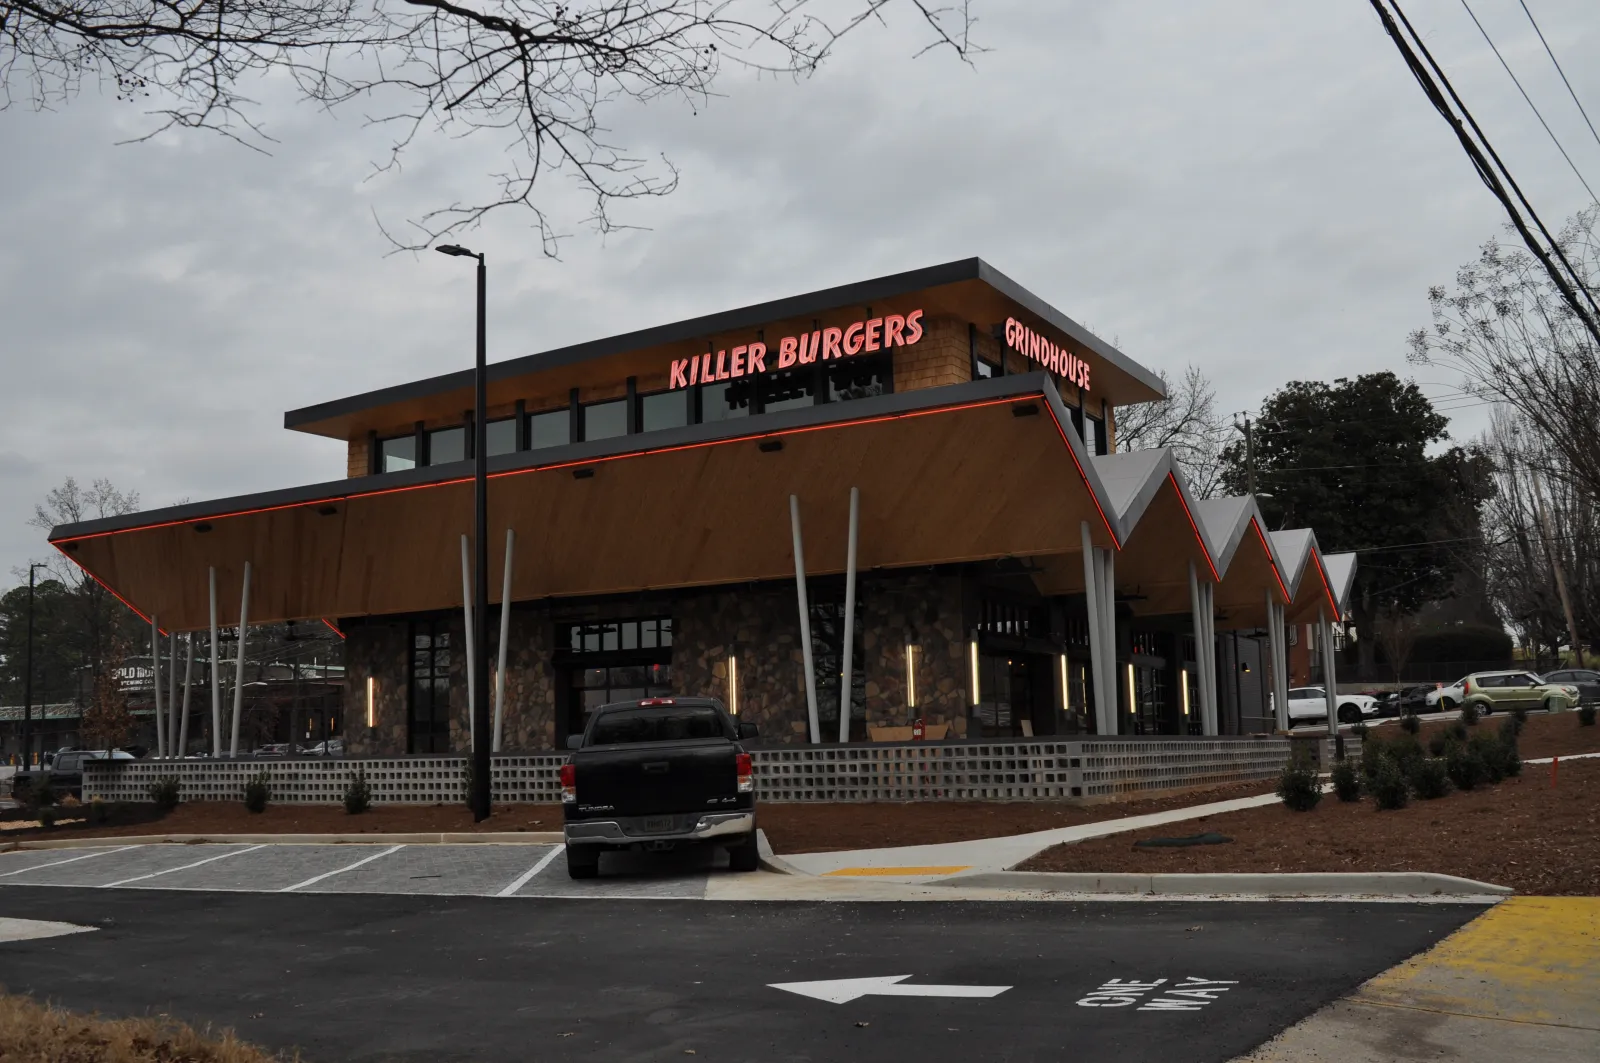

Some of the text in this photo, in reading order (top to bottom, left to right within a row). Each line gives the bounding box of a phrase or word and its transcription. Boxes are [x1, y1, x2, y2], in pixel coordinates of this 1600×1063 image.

[668, 309, 924, 391] KILLER BURGERS
[1004, 316, 1091, 392] GRINDHOUSE
[578, 805, 615, 813] TUNDRA
[1075, 978, 1168, 1008] ONE
[1136, 976, 1240, 1011] WAY
